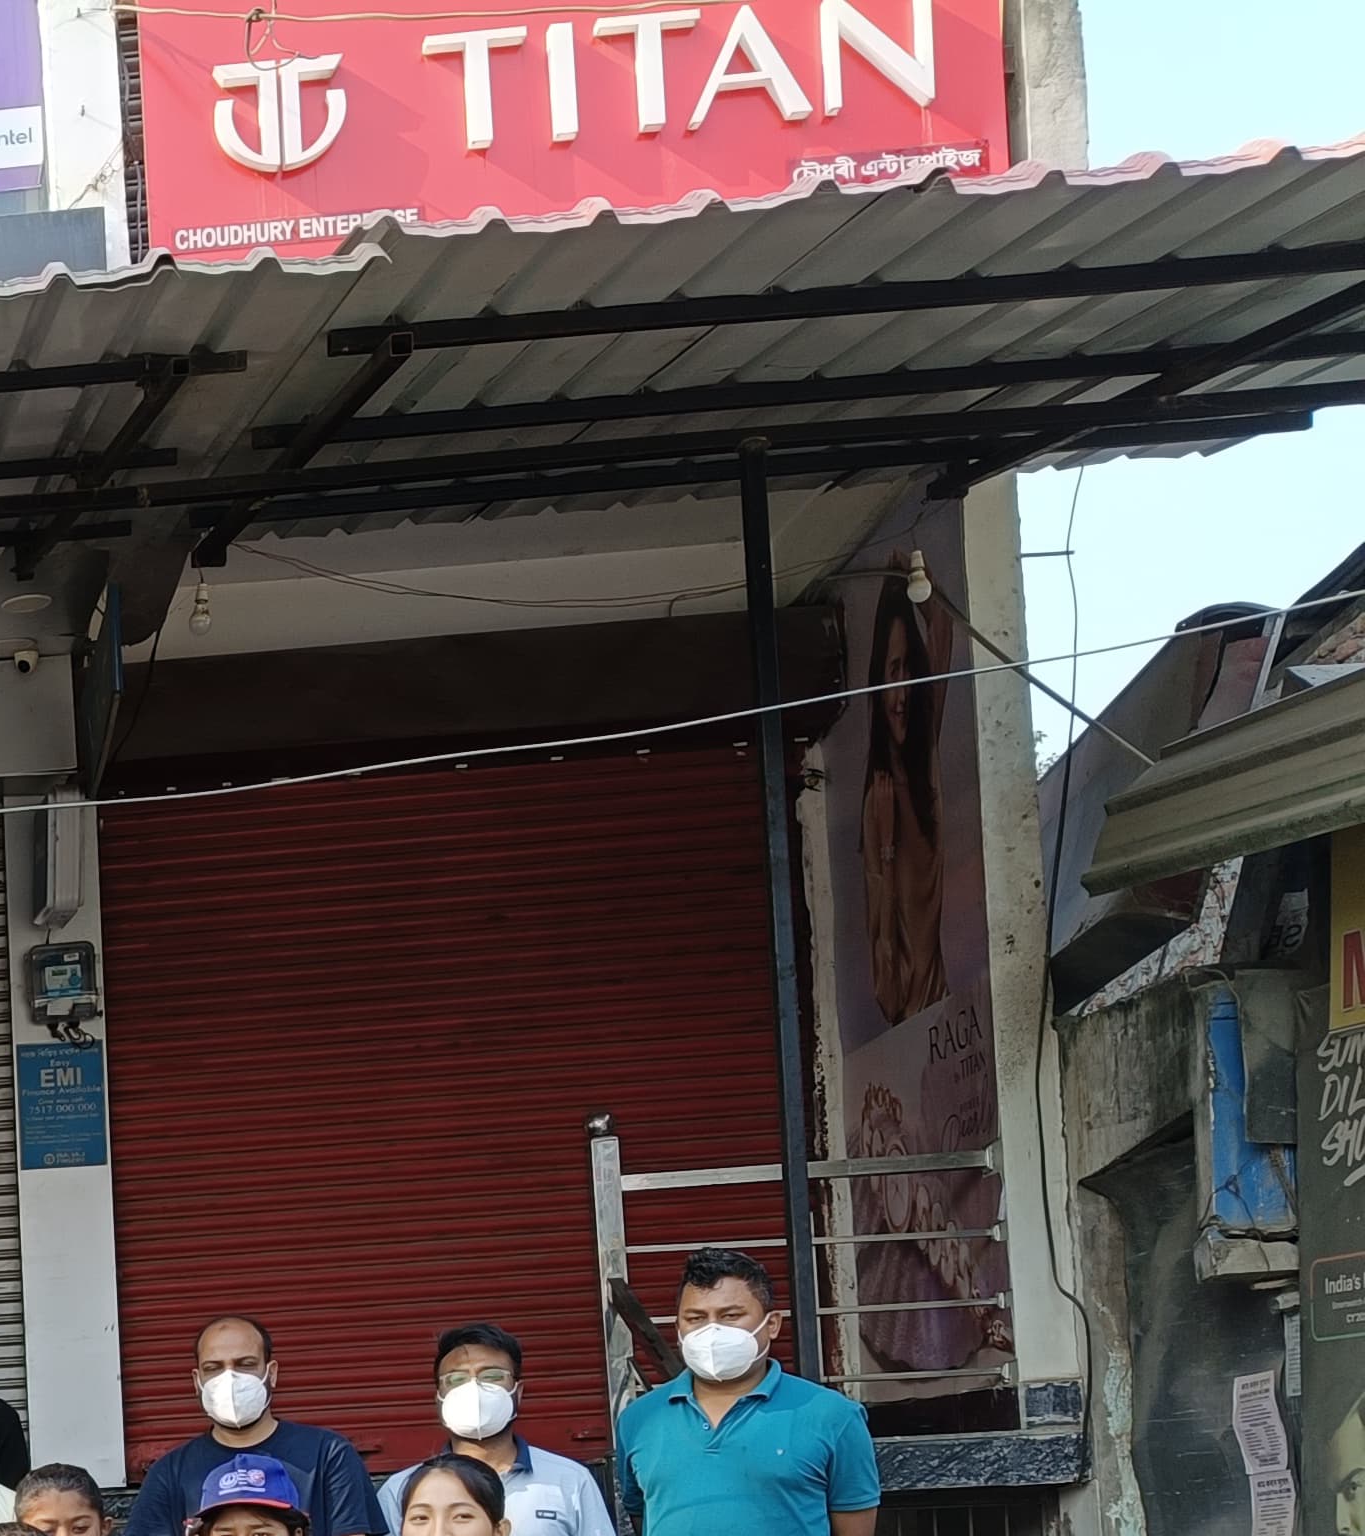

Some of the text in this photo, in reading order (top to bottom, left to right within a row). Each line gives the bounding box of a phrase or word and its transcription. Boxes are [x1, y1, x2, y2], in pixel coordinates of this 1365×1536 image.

[421, 0, 936, 150] TITAN
[175, 219, 295, 250] CHOUDHURY
[929, 1005, 983, 1064] RAGA
[40, 1066, 82, 1088] EMI
[1325, 1273, 1361, 1295] India's
